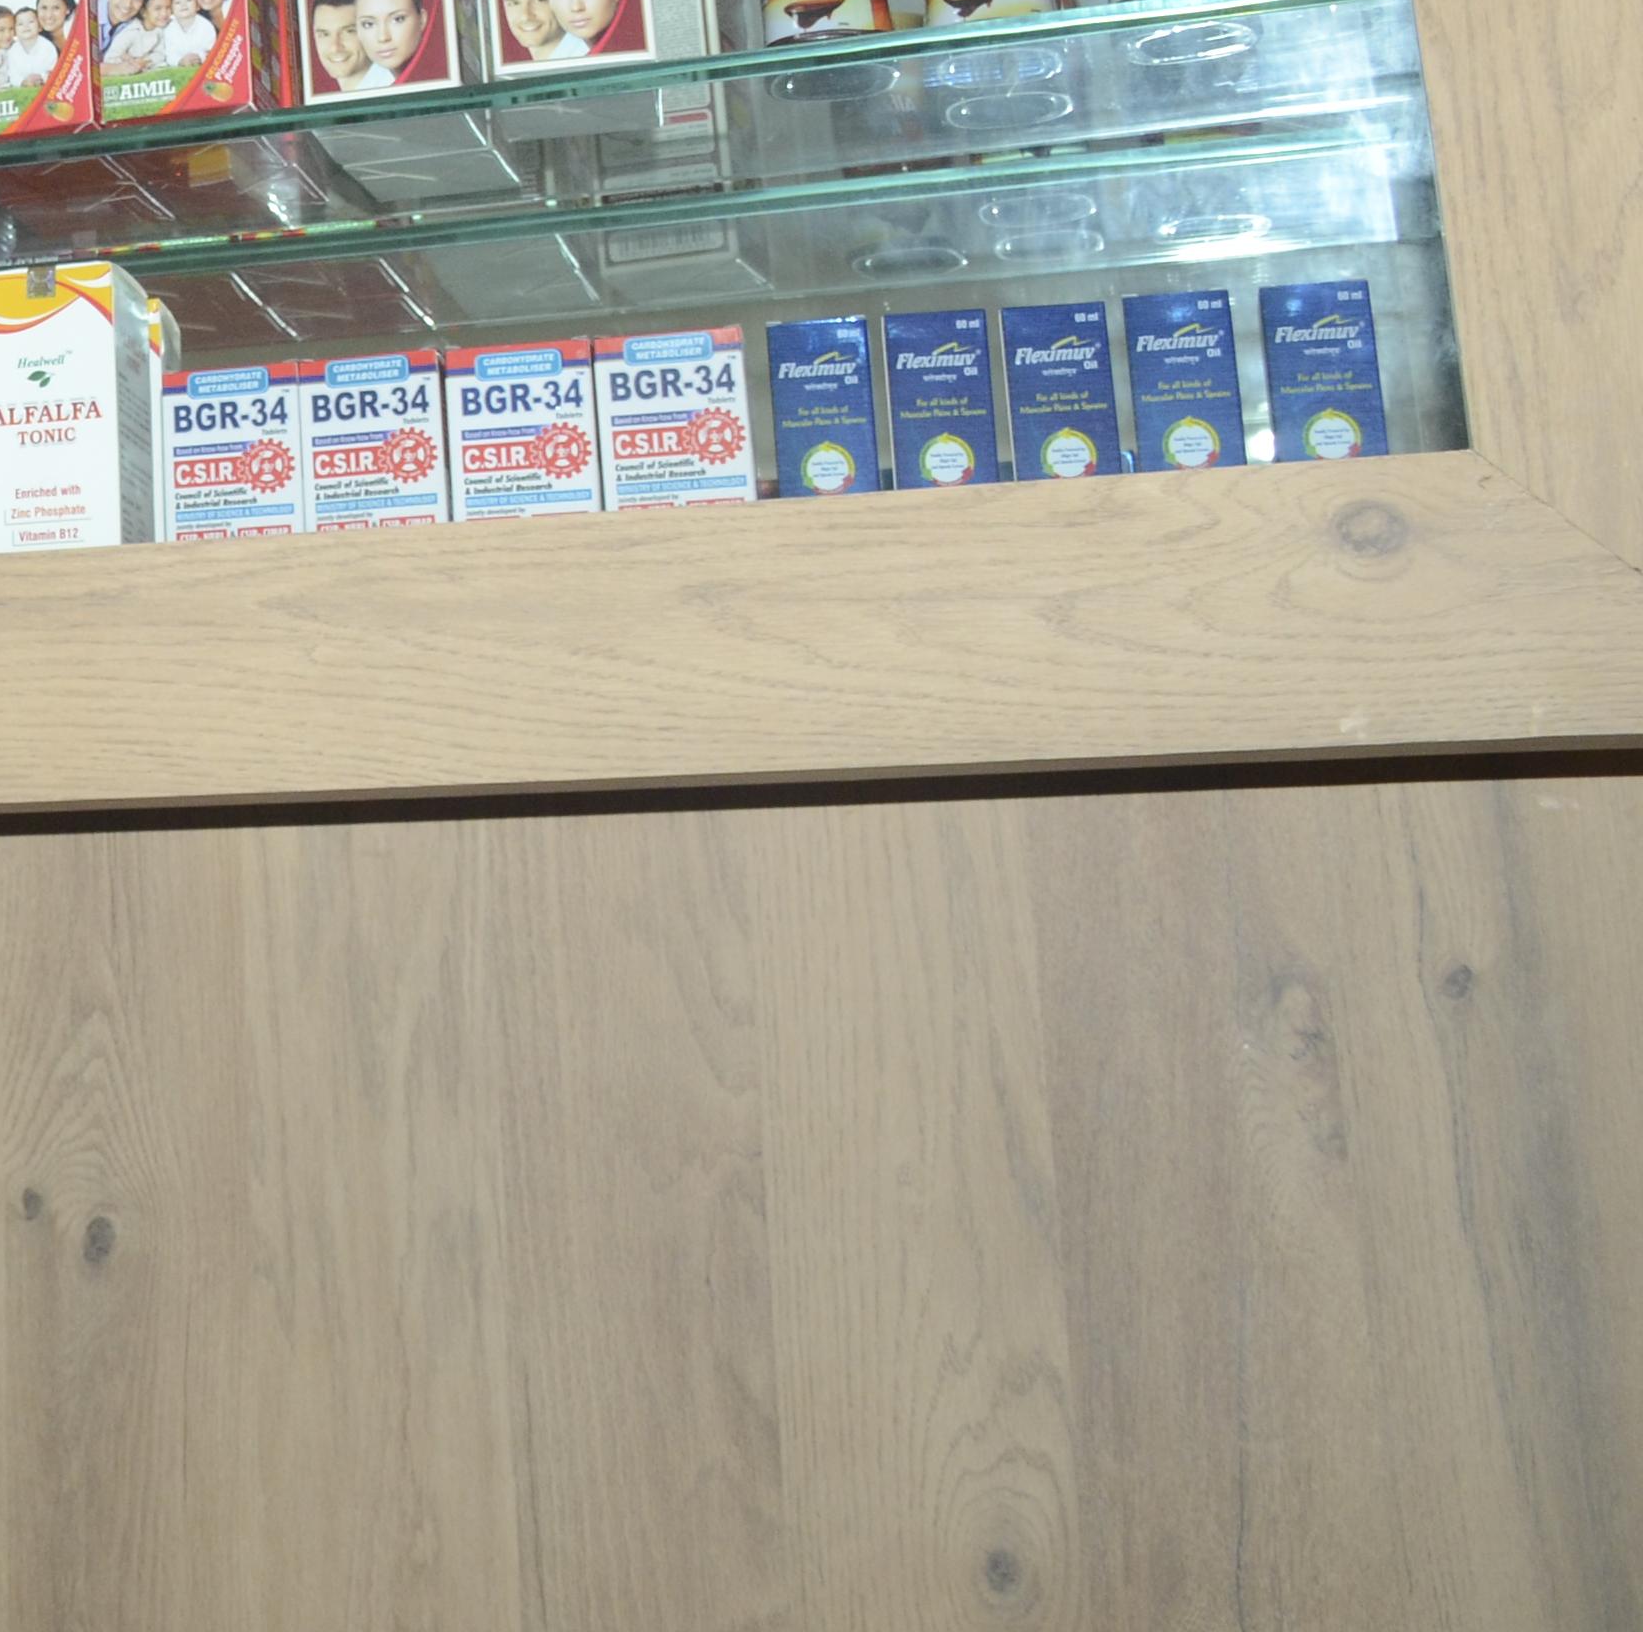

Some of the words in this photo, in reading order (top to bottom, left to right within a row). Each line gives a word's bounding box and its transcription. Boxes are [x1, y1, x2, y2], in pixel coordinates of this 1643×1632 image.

[1137, 334, 1218, 352] Fleximuv
[1275, 325, 1359, 343] Fleximuv
[17, 355, 65, 369] Healwell
[896, 351, 976, 370] Fleximuv
[610, 364, 735, 402] BGR-34
[312, 386, 429, 424] BGR-34
[461, 379, 583, 416] BGR-34
[174, 397, 287, 434] BGR-34
[17, 428, 76, 445] TONIC
[15, 487, 57, 500] Enriched
[61, 485, 81, 496] with
[12, 507, 33, 519] Zinc
[36, 504, 86, 519] Phosphate
[19, 529, 55, 542] Vitamin
[59, 528, 78, 539] B12
